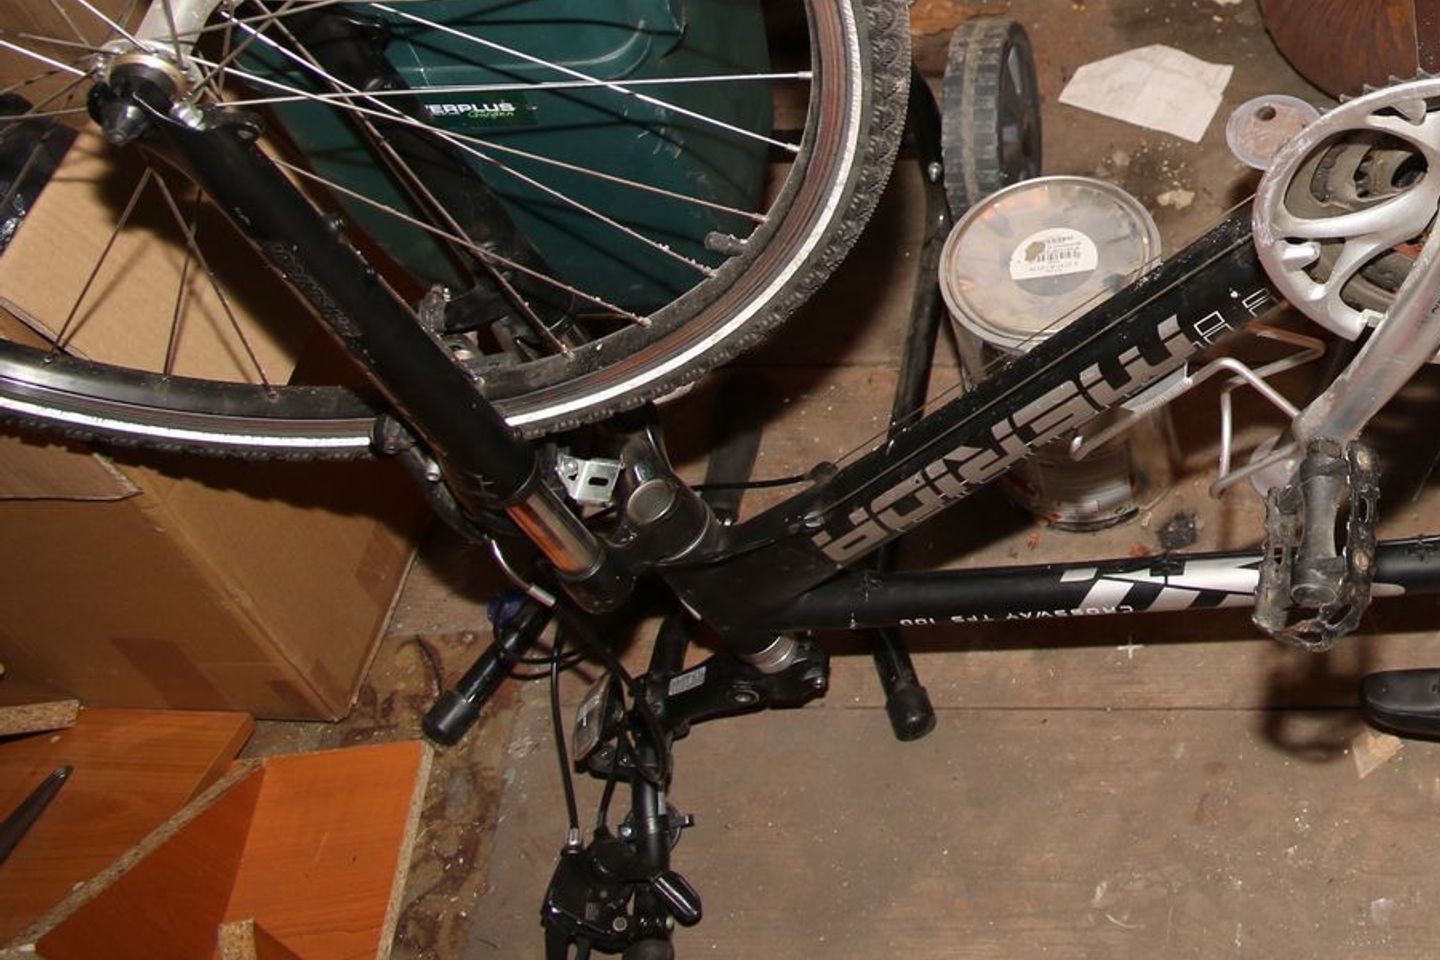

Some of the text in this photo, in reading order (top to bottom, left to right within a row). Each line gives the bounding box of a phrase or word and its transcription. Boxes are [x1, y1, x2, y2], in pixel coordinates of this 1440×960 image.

[424, 101, 516, 118] ERPLUS
[811, 313, 1200, 563] MERIDA
[1005, 605, 1134, 620] CROSSWAY
